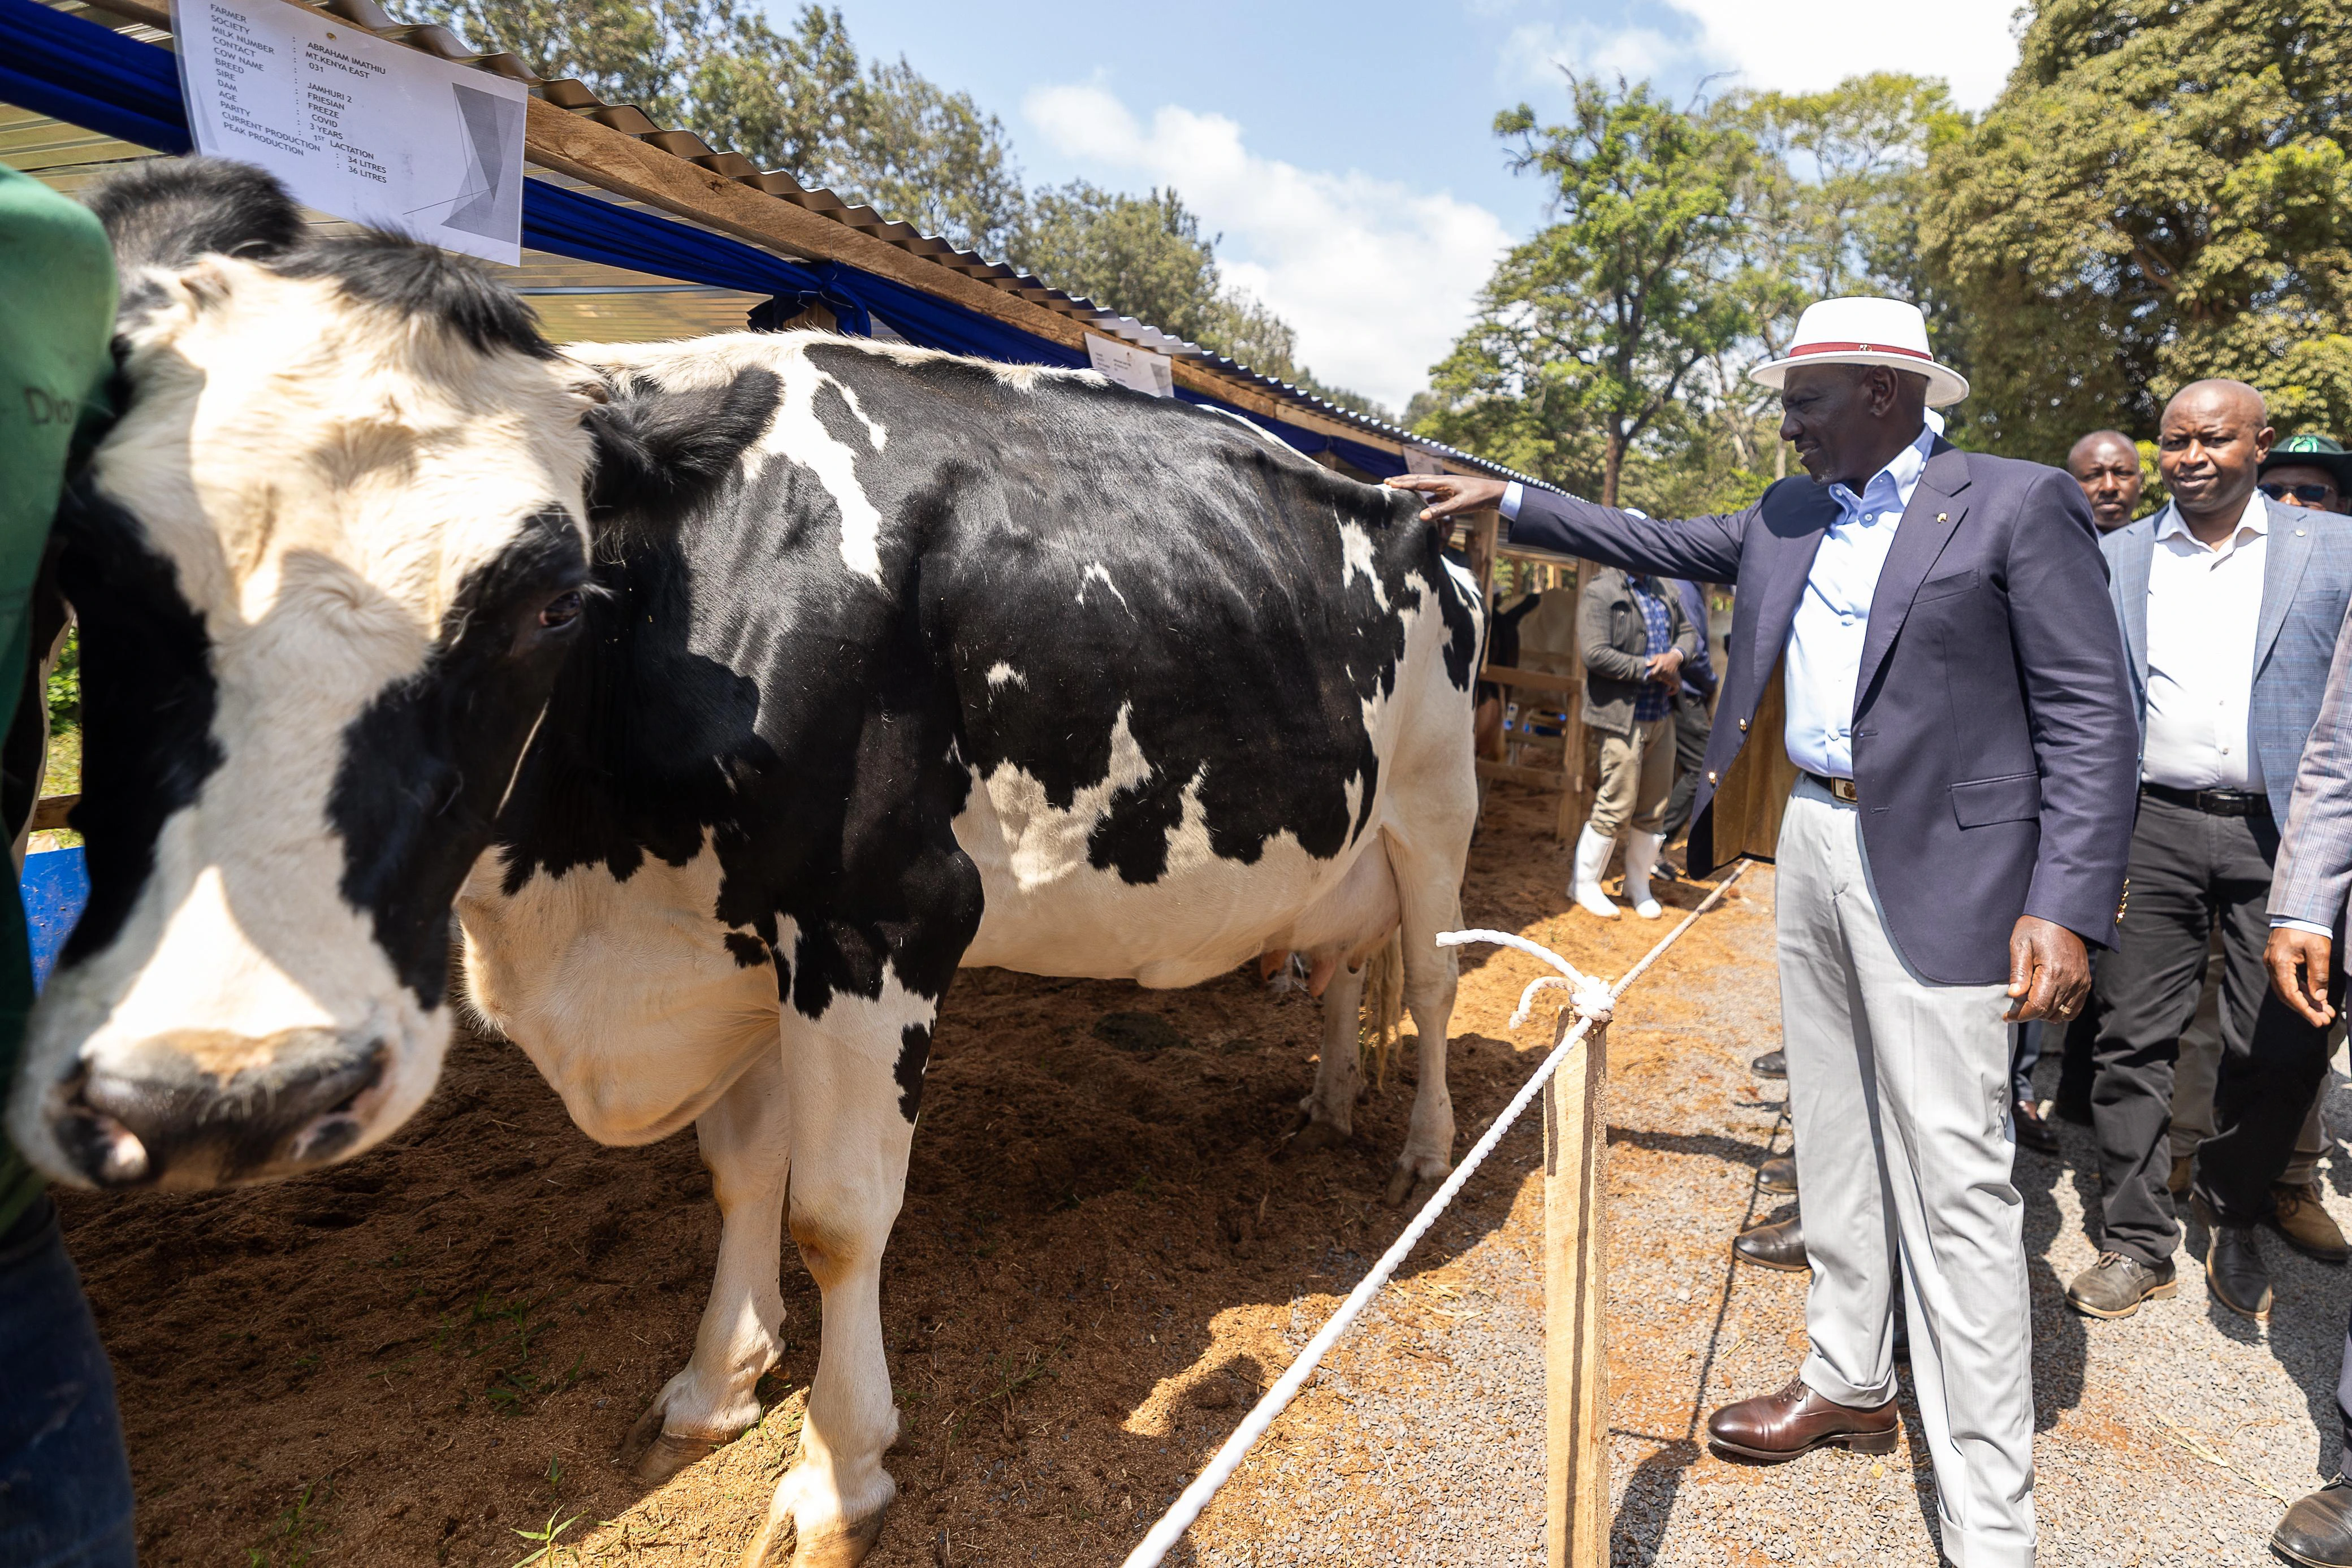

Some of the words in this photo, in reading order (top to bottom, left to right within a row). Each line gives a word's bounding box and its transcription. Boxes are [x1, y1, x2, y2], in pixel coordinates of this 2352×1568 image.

[211, 4, 247, 23] FARMER
[308, 42, 349, 62] ABRAHAM
[352, 58, 386, 75] IMATHIU
[211, 15, 250, 34] SOCIETY
[349, 67, 370, 79] EAST
[212, 26, 234, 38] MILK
[237, 36, 275, 54] NUMBER
[309, 63, 323, 72] 031
[213, 37, 256, 57] CONTACT
[214, 47, 236, 59] COW
[239, 57, 265, 71] NAME
[308, 82, 345, 100] JAMHURI
[215, 58, 244, 73] BREED
[308, 92, 345, 110] FRIESIAN
[216, 69, 236, 81] SIRE
[309, 103, 340, 119] FREEZE
[218, 79, 237, 92] DAM
[312, 114, 338, 127] COVID
[219, 91, 237, 102] AGE
[317, 125, 343, 140] YEARS
[220, 101, 250, 116] PARITY
[330, 140, 374, 159] LACTATION
[222, 112, 262, 131] CURRENT
[265, 128, 321, 152] PRODUCTION
[360, 159, 387, 174] LITRES
[224, 122, 245, 135] PEAK
[249, 131, 304, 156] PRODUCTION
[348, 166, 358, 174] 36
[360, 170, 387, 184] LITRES
